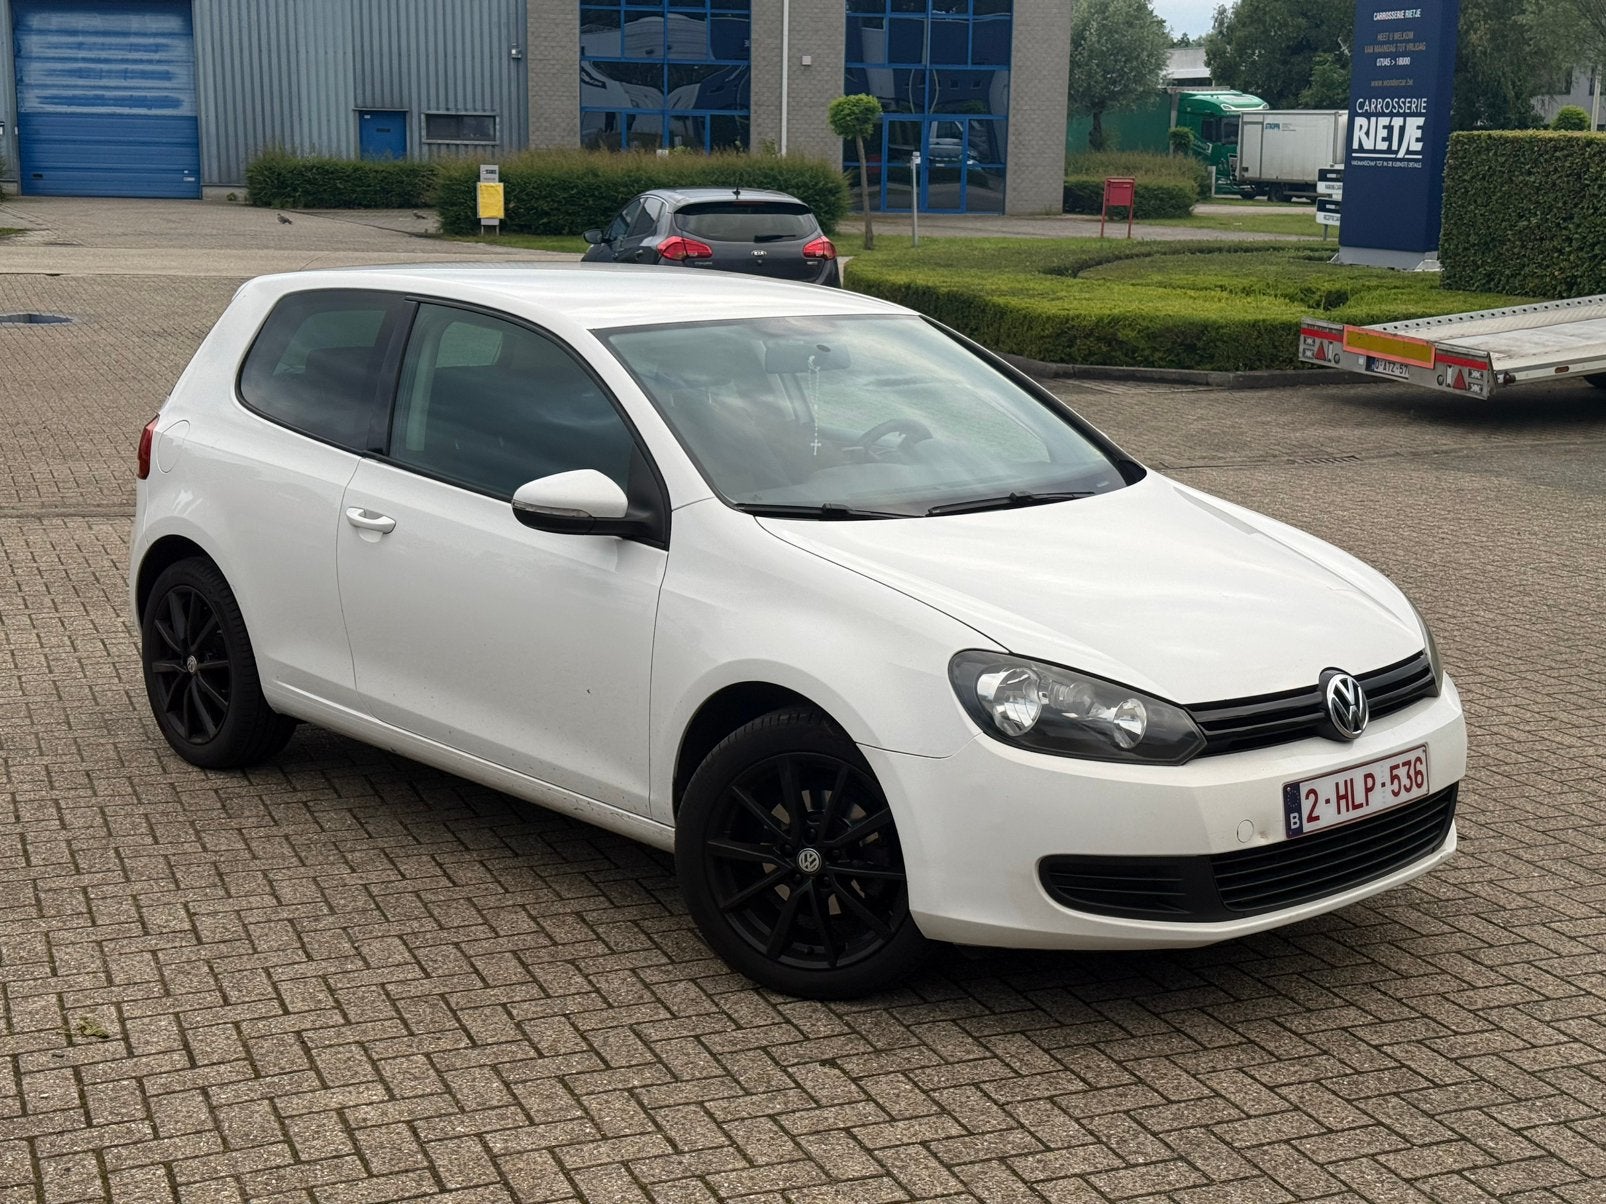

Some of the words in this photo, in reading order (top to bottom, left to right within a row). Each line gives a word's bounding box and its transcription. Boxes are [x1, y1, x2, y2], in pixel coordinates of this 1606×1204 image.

[1373, 11, 1404, 20] CARROSSERIE
[1405, 9, 1421, 18] RIETJE
[1356, 98, 1427, 113] CARROSSERIE
[1352, 116, 1425, 158] RIETJE
[1305, 756, 1425, 823] 2-HLP-536
[1290, 813, 1300, 829] B
